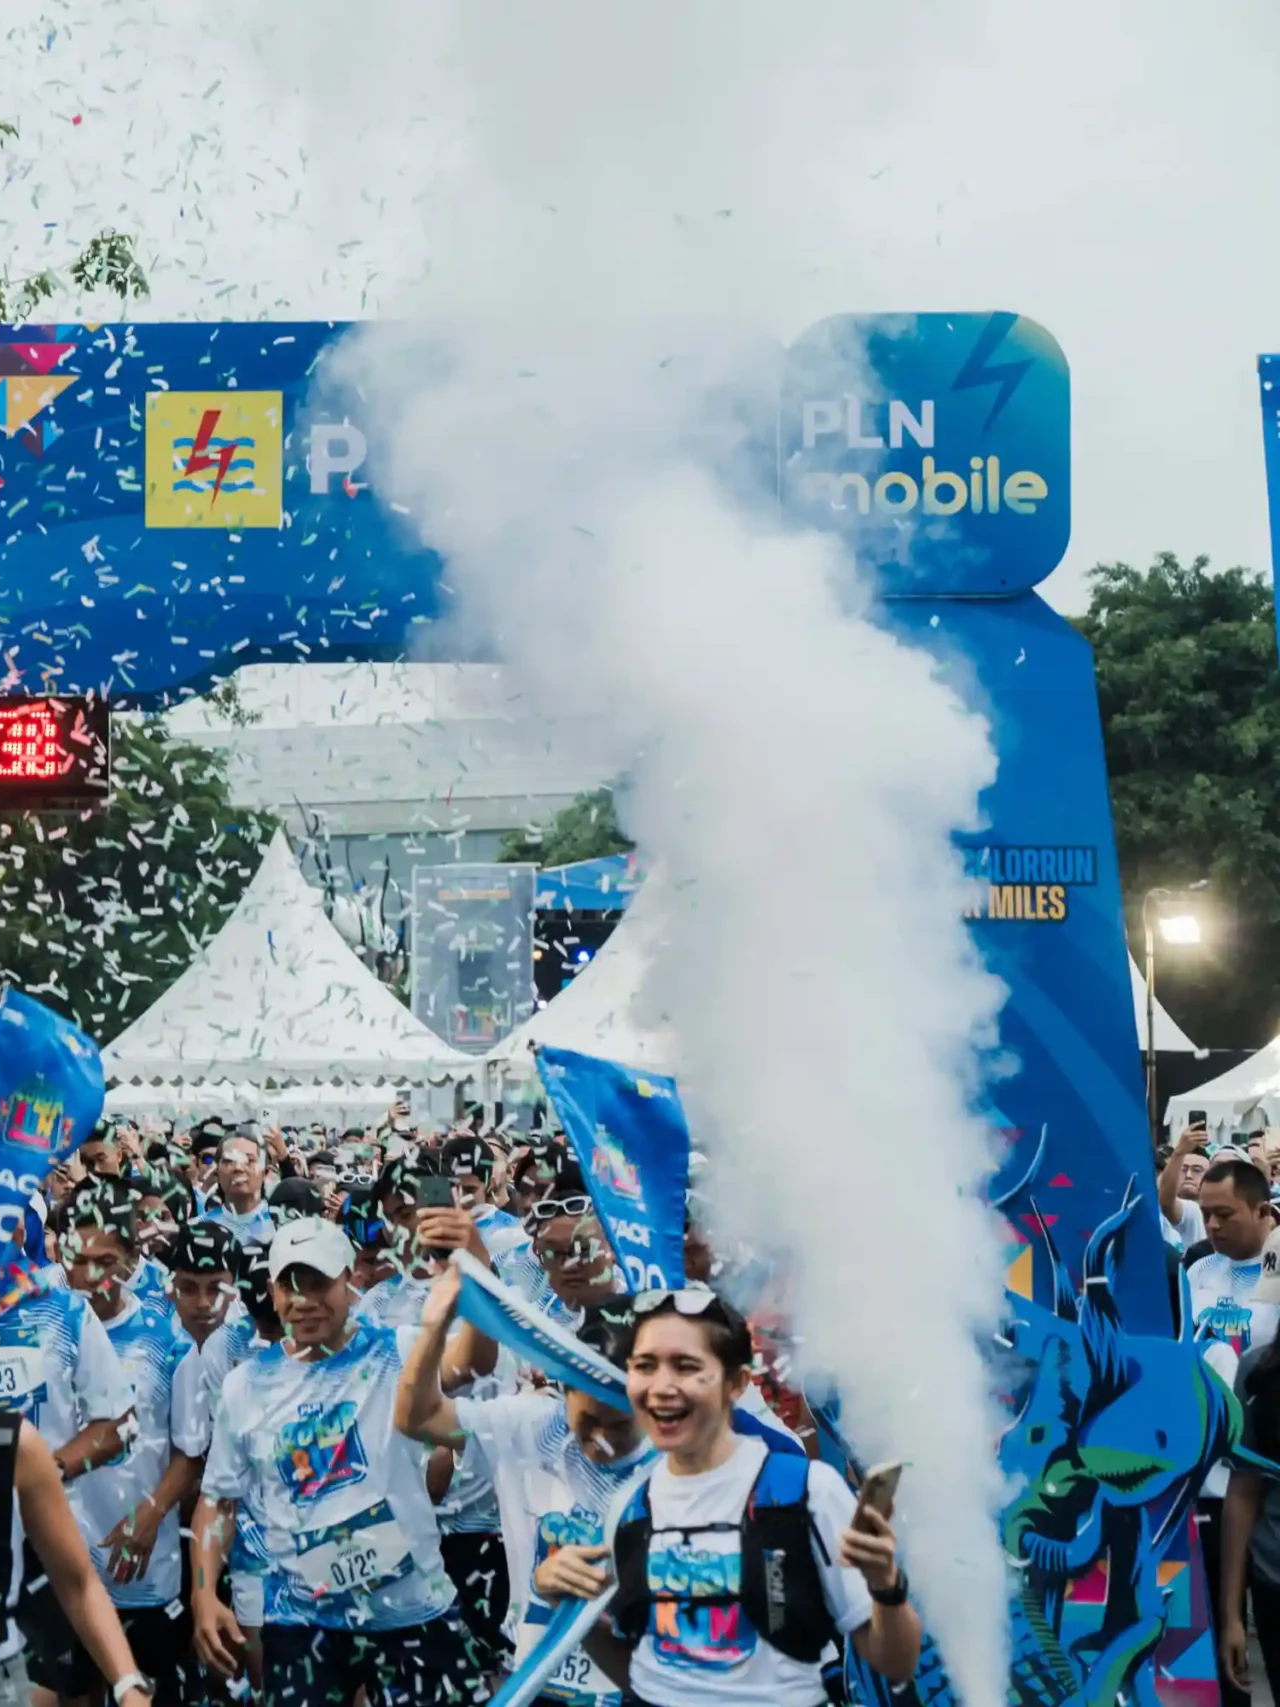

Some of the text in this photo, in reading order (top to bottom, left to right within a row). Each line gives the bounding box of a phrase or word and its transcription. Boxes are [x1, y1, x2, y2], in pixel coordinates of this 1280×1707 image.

[802, 399, 935, 449] PLN
[802, 455, 1048, 516] mobile
[988, 885, 1066, 920] MILES
